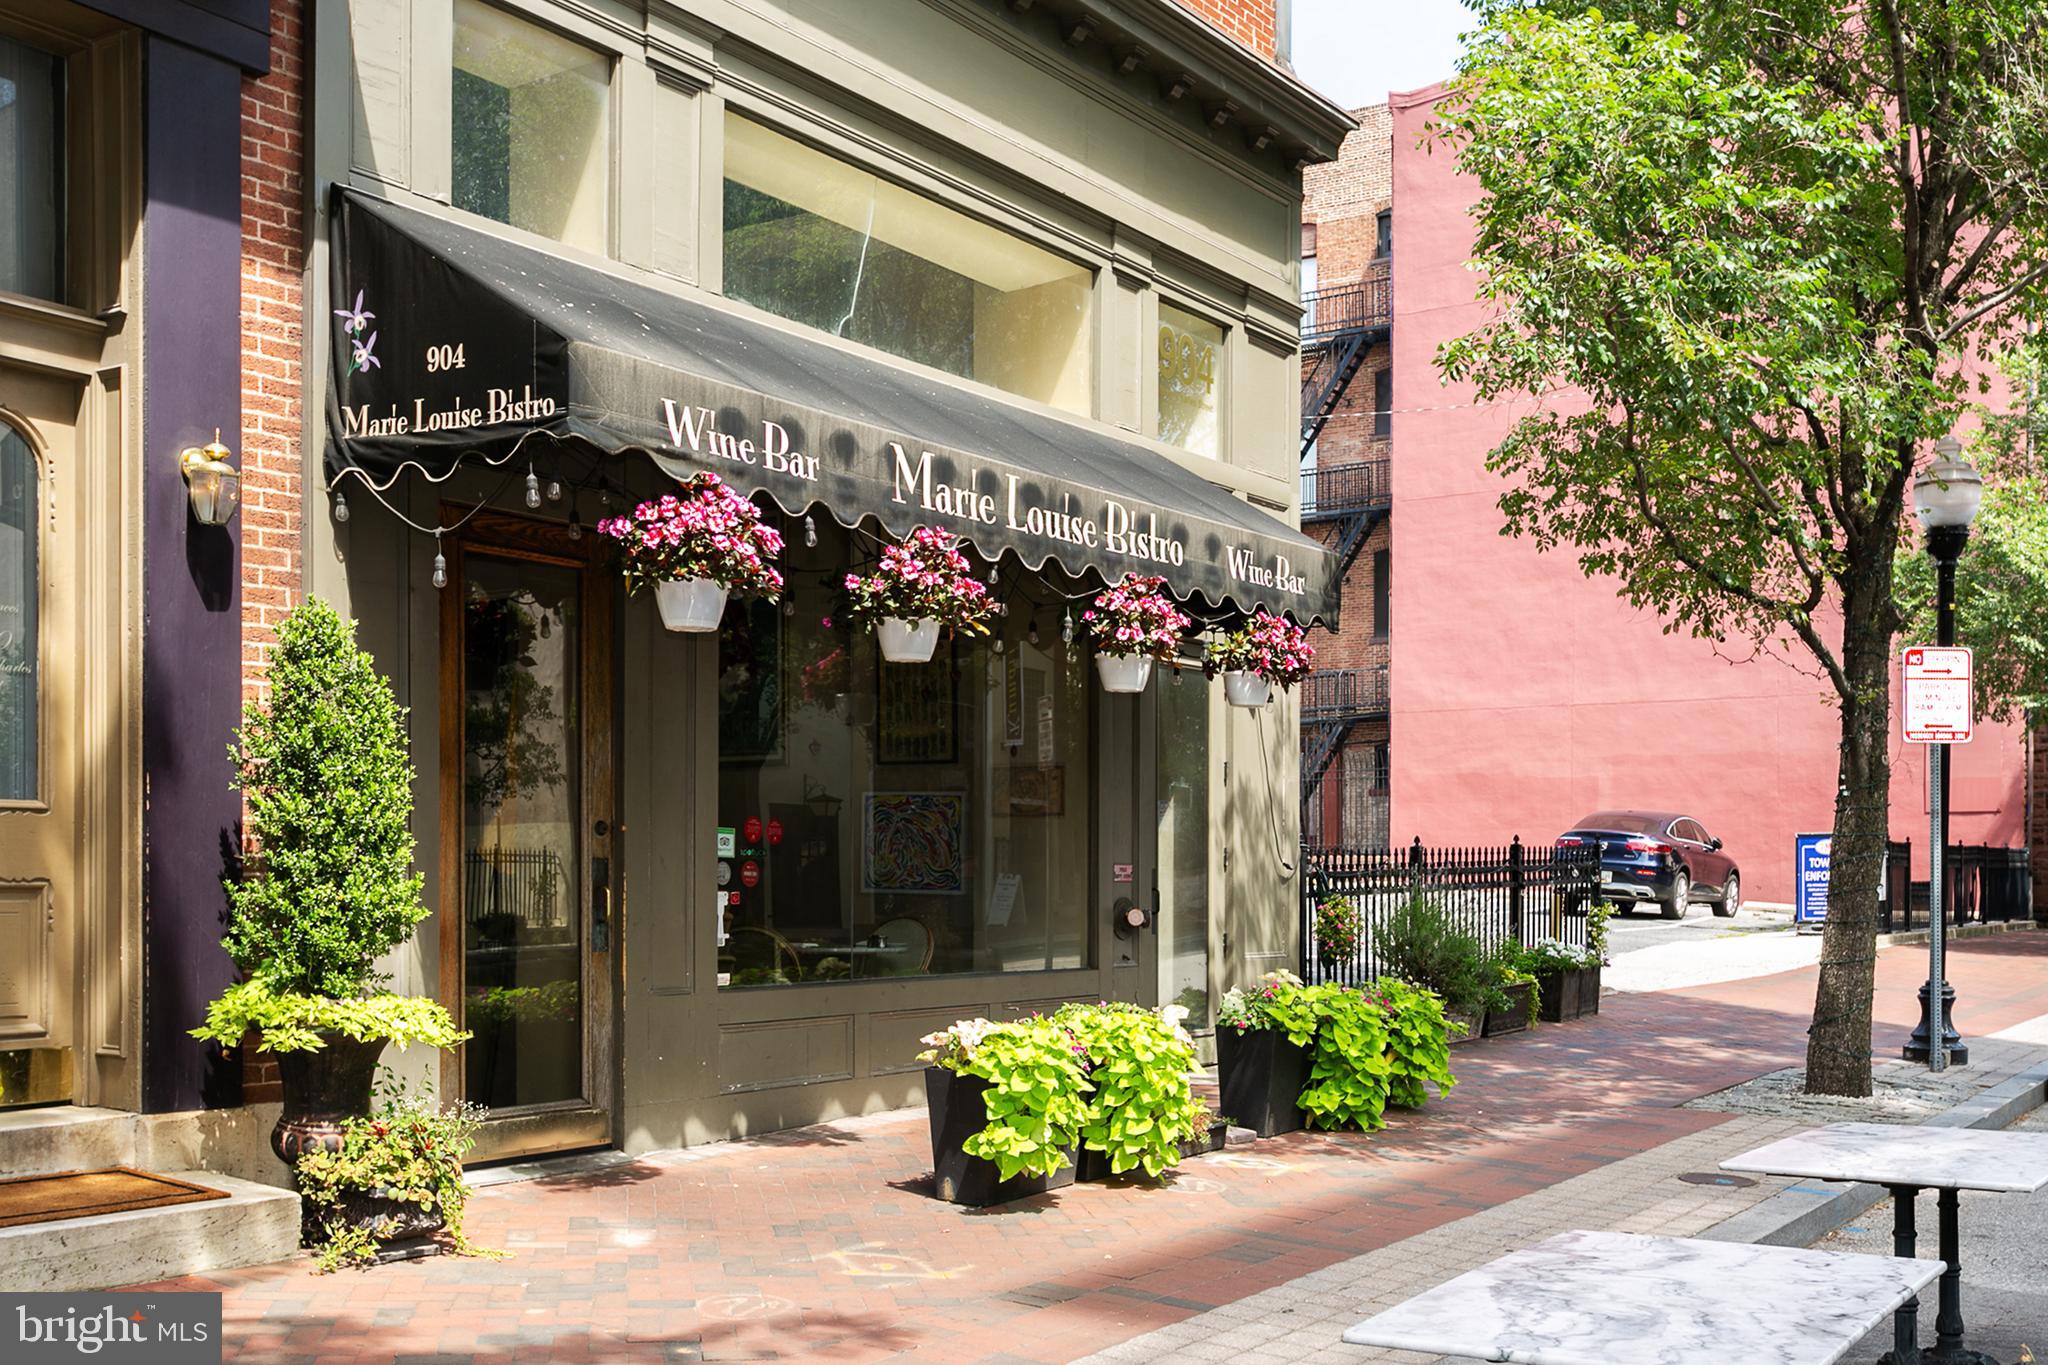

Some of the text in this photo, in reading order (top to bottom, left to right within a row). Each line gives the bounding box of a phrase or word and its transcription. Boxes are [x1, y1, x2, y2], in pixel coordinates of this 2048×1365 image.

[426, 343, 466, 373] 904
[1158, 325, 1215, 395] 904
[341, 385, 556, 439] Marie Louise Bistro
[660, 397, 821, 483] Wine Bar
[889, 441, 1185, 568] Marie Louise Bistro
[1225, 544, 1307, 596] Wine Bar
[1908, 653, 1922, 665] NO
